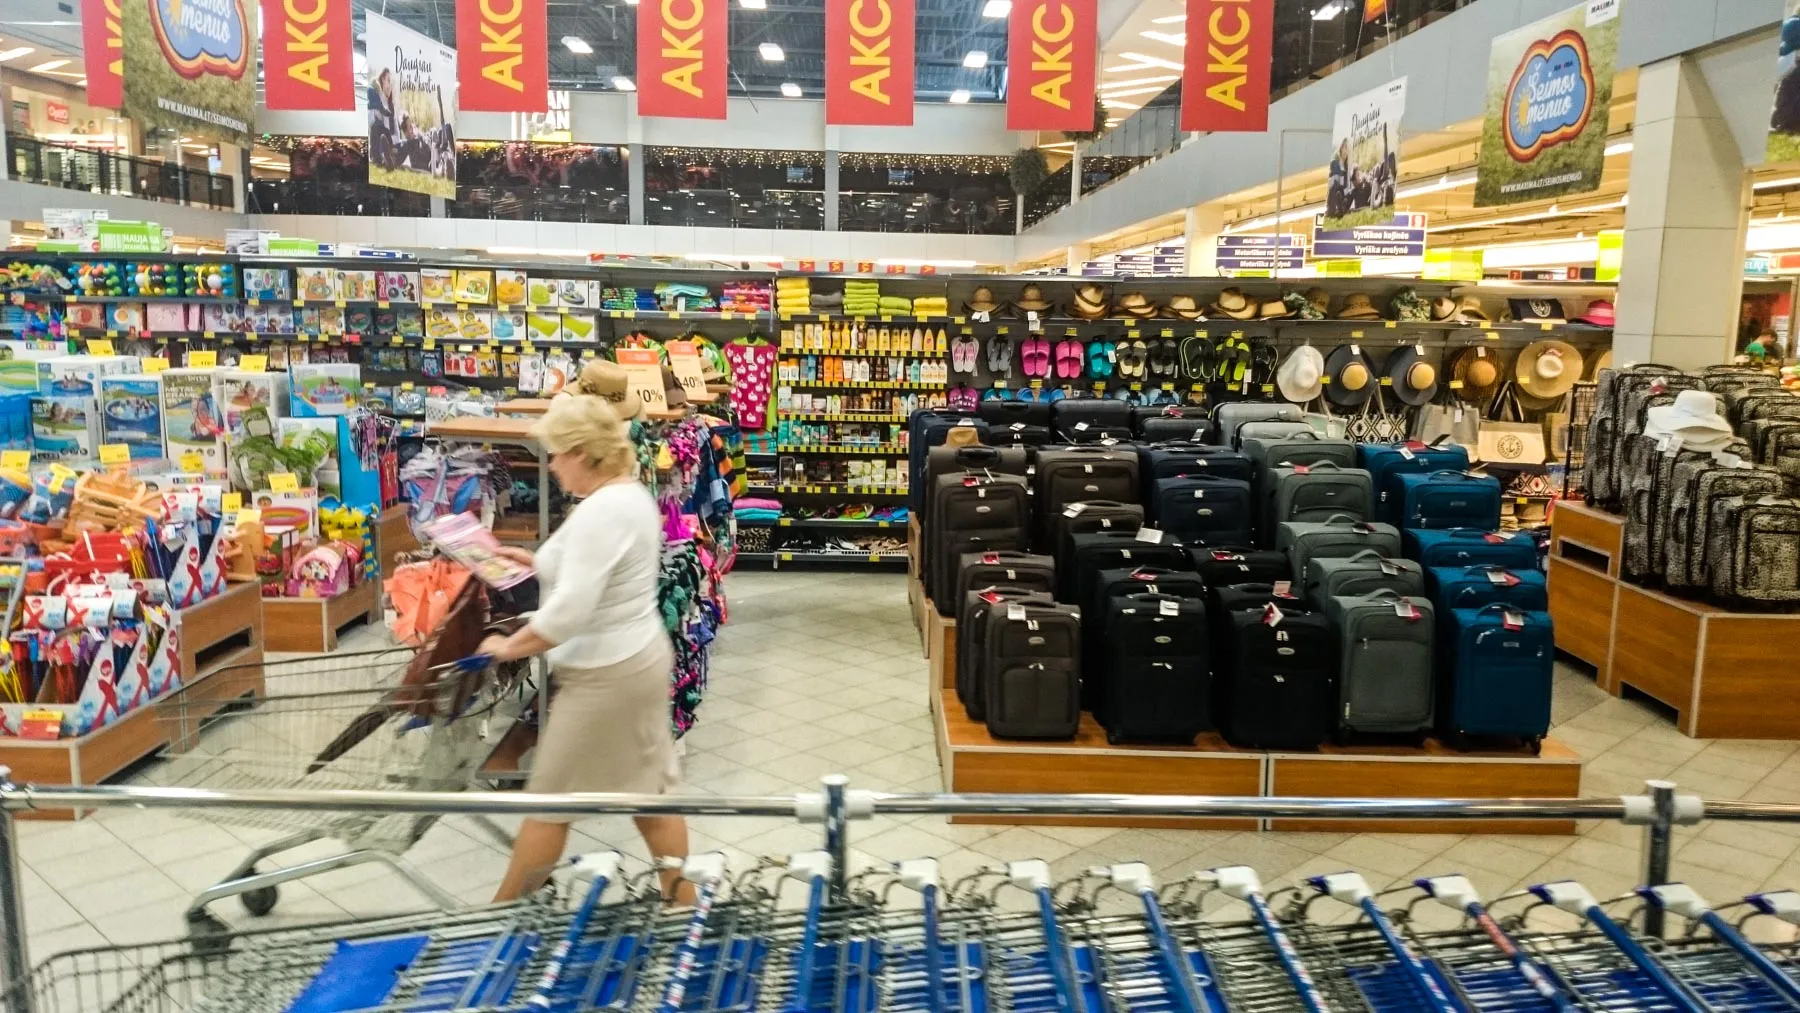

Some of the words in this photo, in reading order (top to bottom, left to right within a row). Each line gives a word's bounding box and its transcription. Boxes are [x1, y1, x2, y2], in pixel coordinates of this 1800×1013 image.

[180, 5, 231, 43] menuo
[1528, 62, 1576, 103] Šeimos
[1526, 95, 1572, 124] menuo
